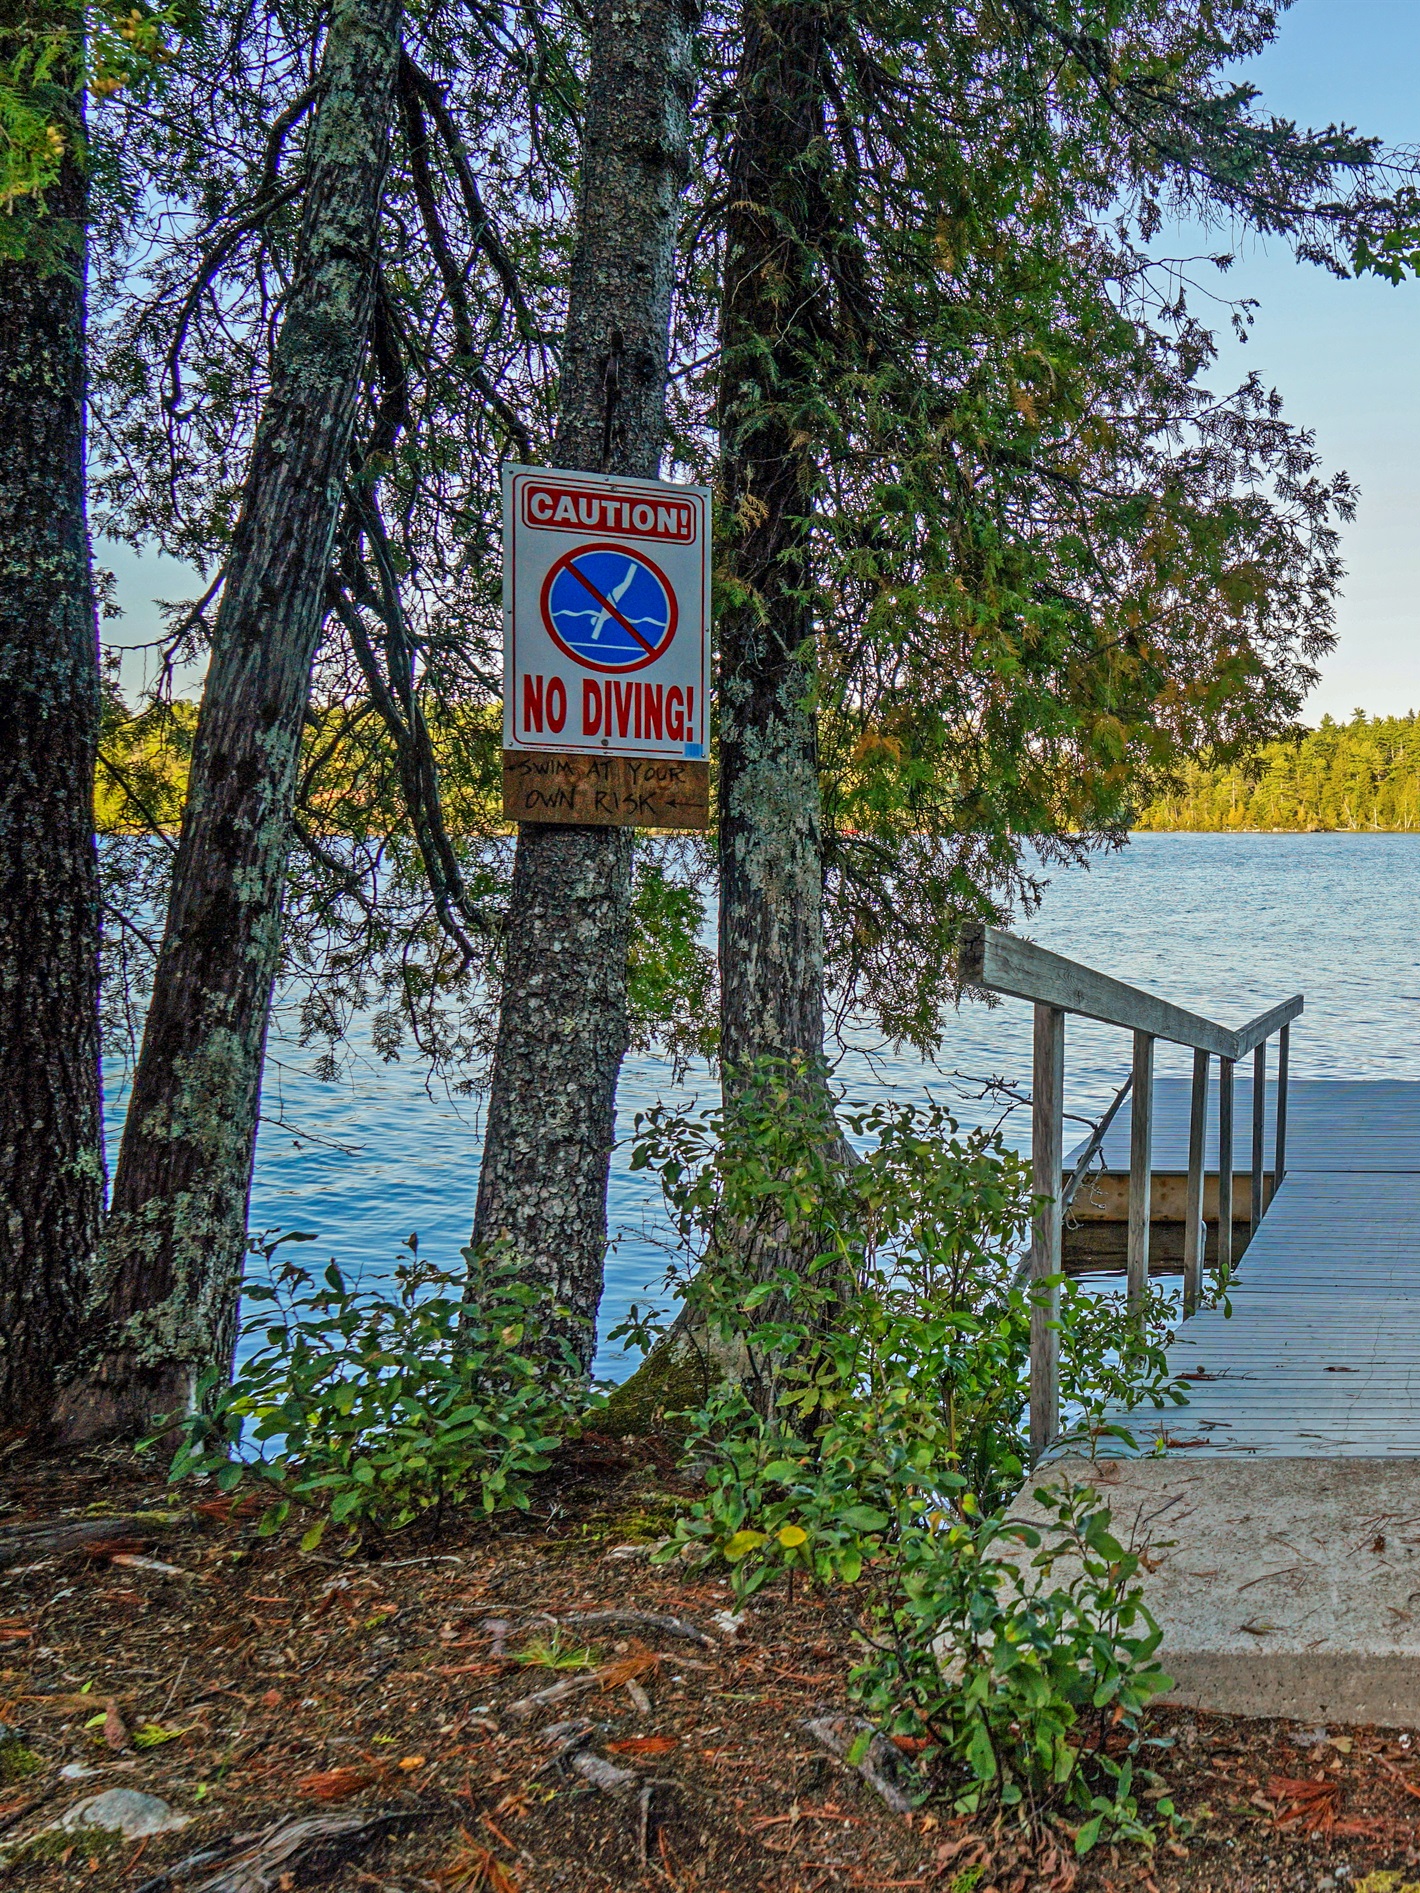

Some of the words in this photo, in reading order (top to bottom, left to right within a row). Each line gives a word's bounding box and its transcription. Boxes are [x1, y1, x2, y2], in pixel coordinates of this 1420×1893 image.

[530, 492, 689, 535] CAUTION!
[523, 674, 567, 734] NO
[582, 678, 694, 742] DIVING!
[518, 758, 576, 777] SWIM
[586, 760, 614, 782] AT
[627, 762, 686, 786] YOUR
[525, 785, 576, 811] OWN
[595, 790, 657, 816] RISK
